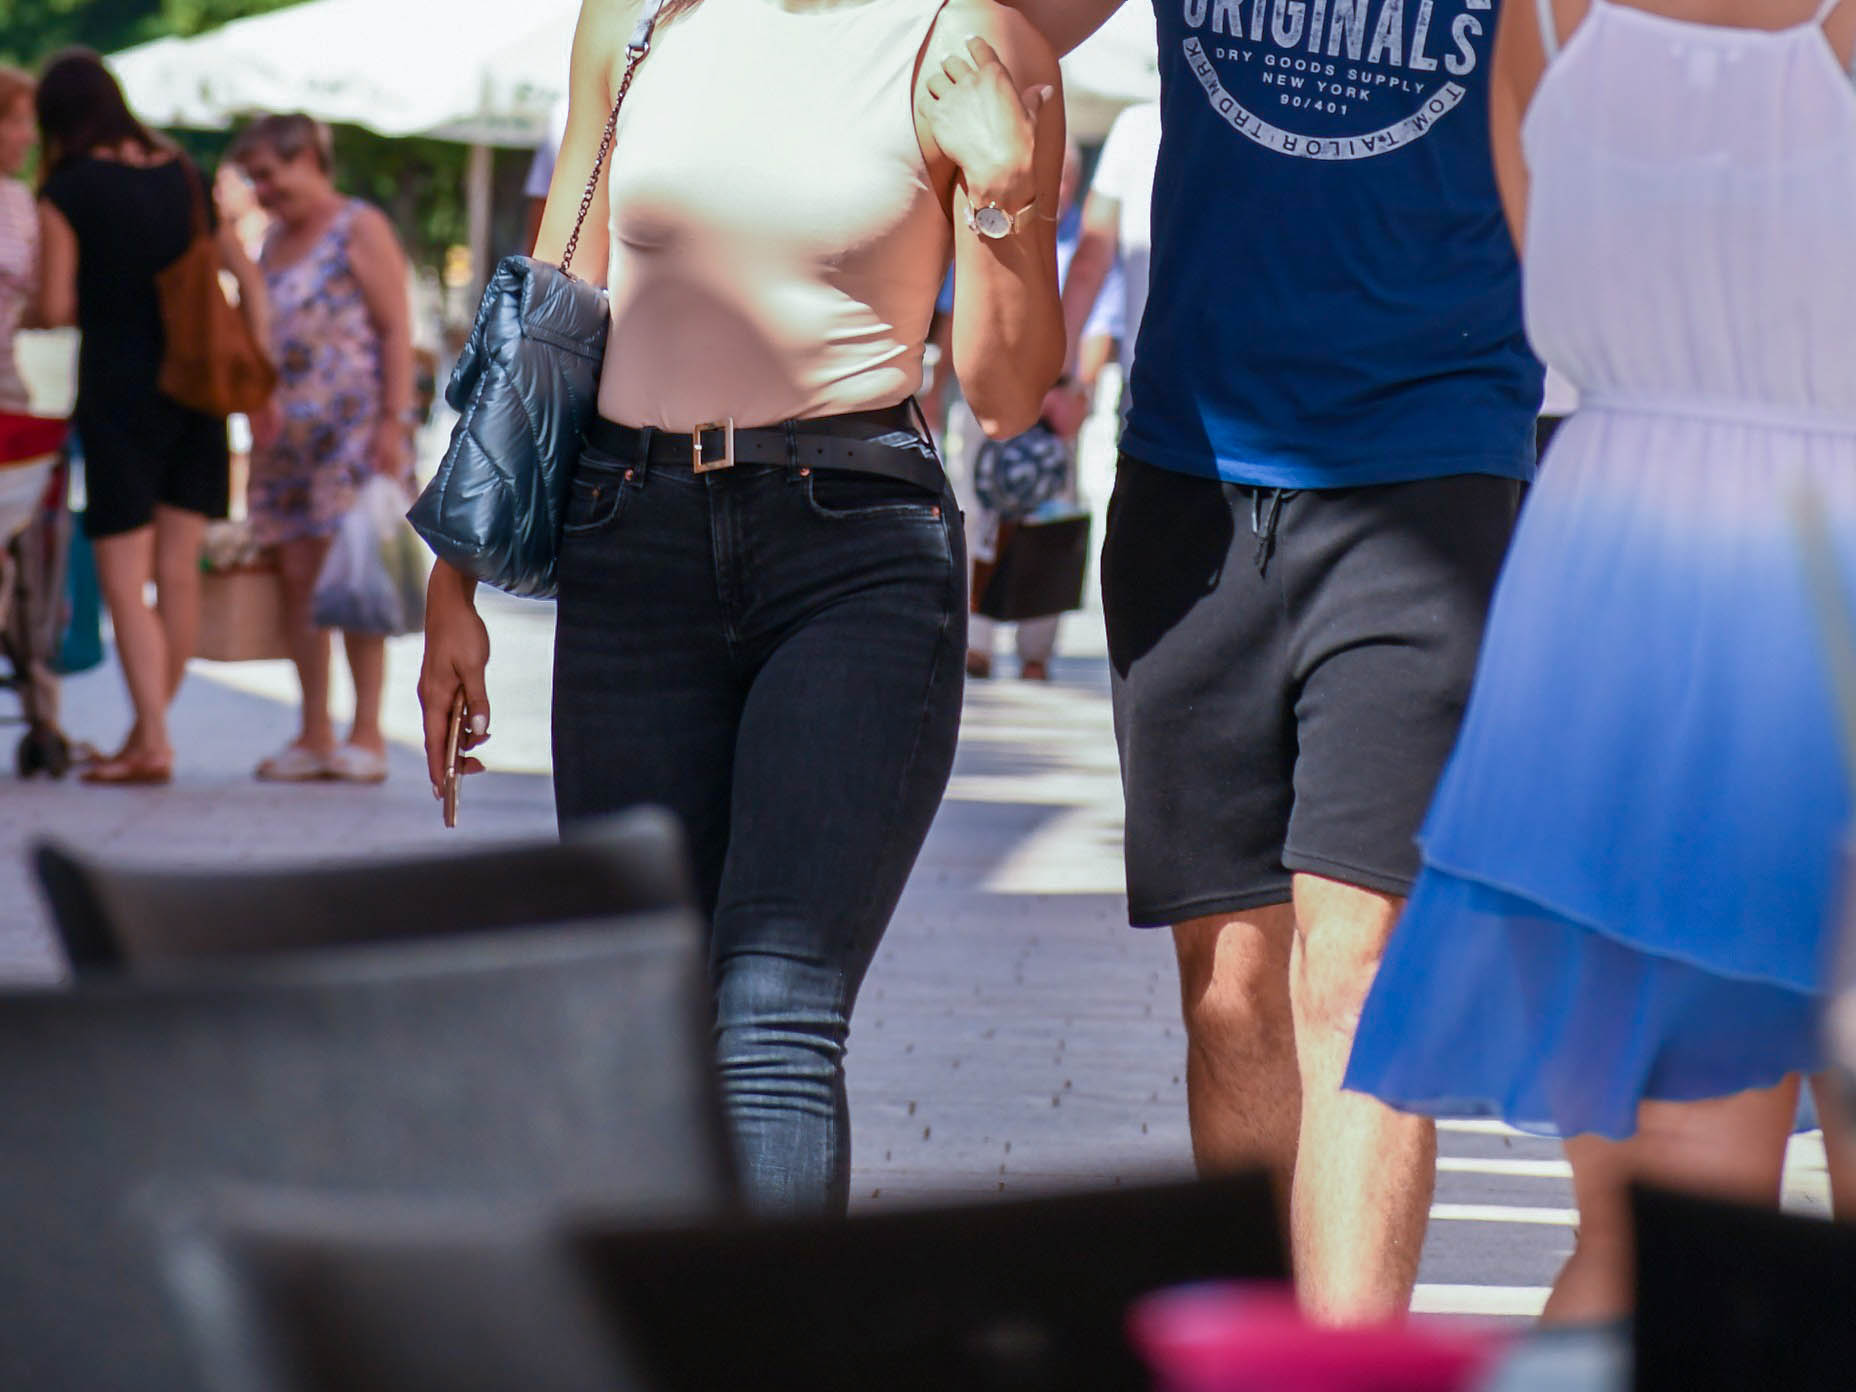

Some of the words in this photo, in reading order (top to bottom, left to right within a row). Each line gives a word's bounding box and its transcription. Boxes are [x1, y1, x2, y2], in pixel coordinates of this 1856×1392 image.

[1215, 48, 1253, 62] DRY
[1264, 54, 1336, 76] GOODS
[1347, 69, 1425, 94] SUPPLY
[1262, 72, 1305, 89] NEW
[1316, 80, 1371, 101] YORK
[1185, 41, 1262, 139] TRDMRK
[1280, 94, 1348, 116] 90/401
[1412, 88, 1462, 132] TOM
[1282, 131, 1399, 156] TAILOR
